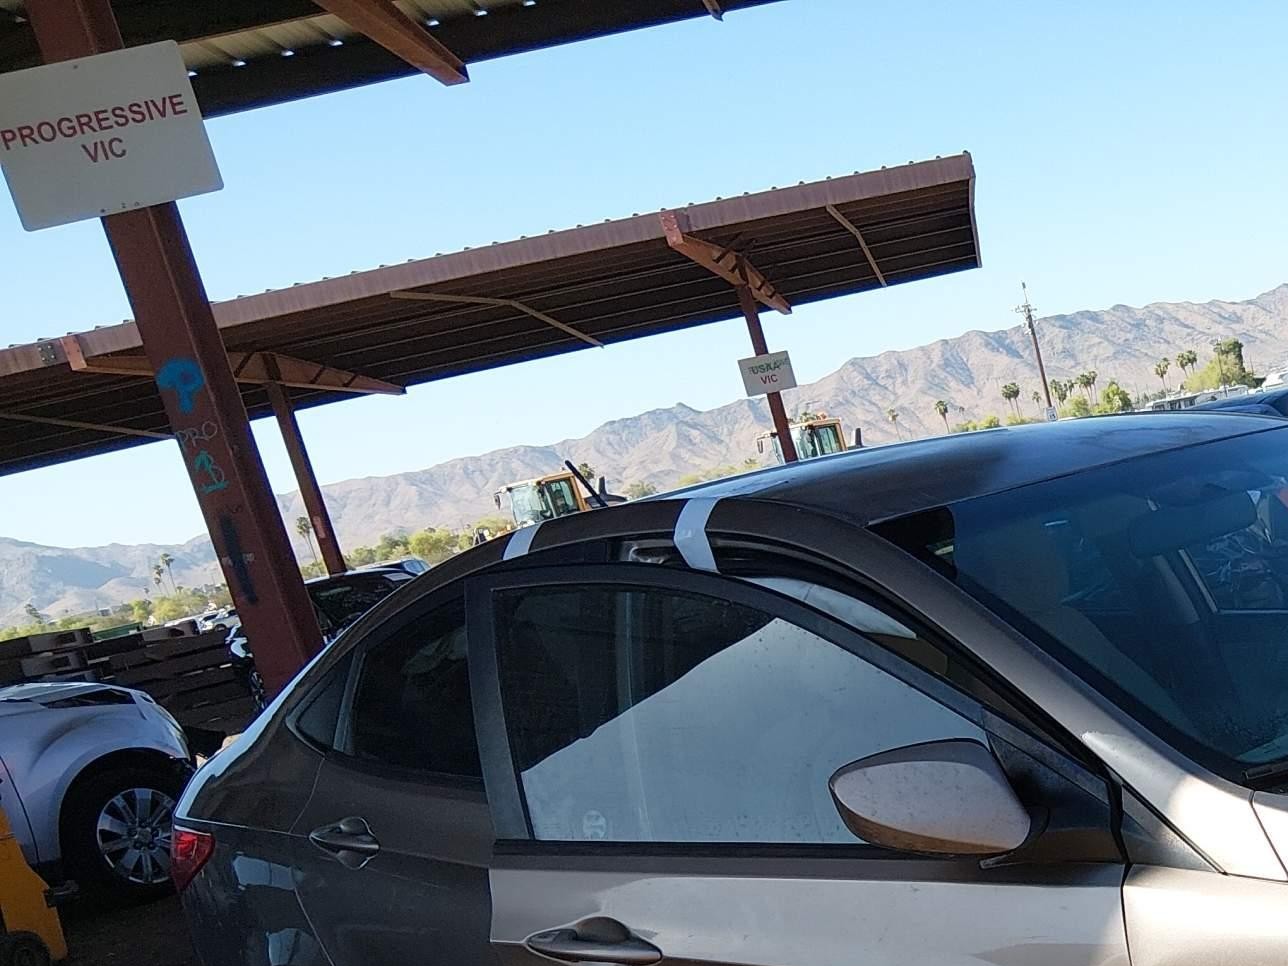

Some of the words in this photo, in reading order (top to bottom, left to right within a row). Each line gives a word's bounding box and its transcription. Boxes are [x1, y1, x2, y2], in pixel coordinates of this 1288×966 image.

[0, 93, 188, 151] PROGRESSIVE
[81, 137, 127, 163] VIC
[760, 374, 778, 385] VIC
